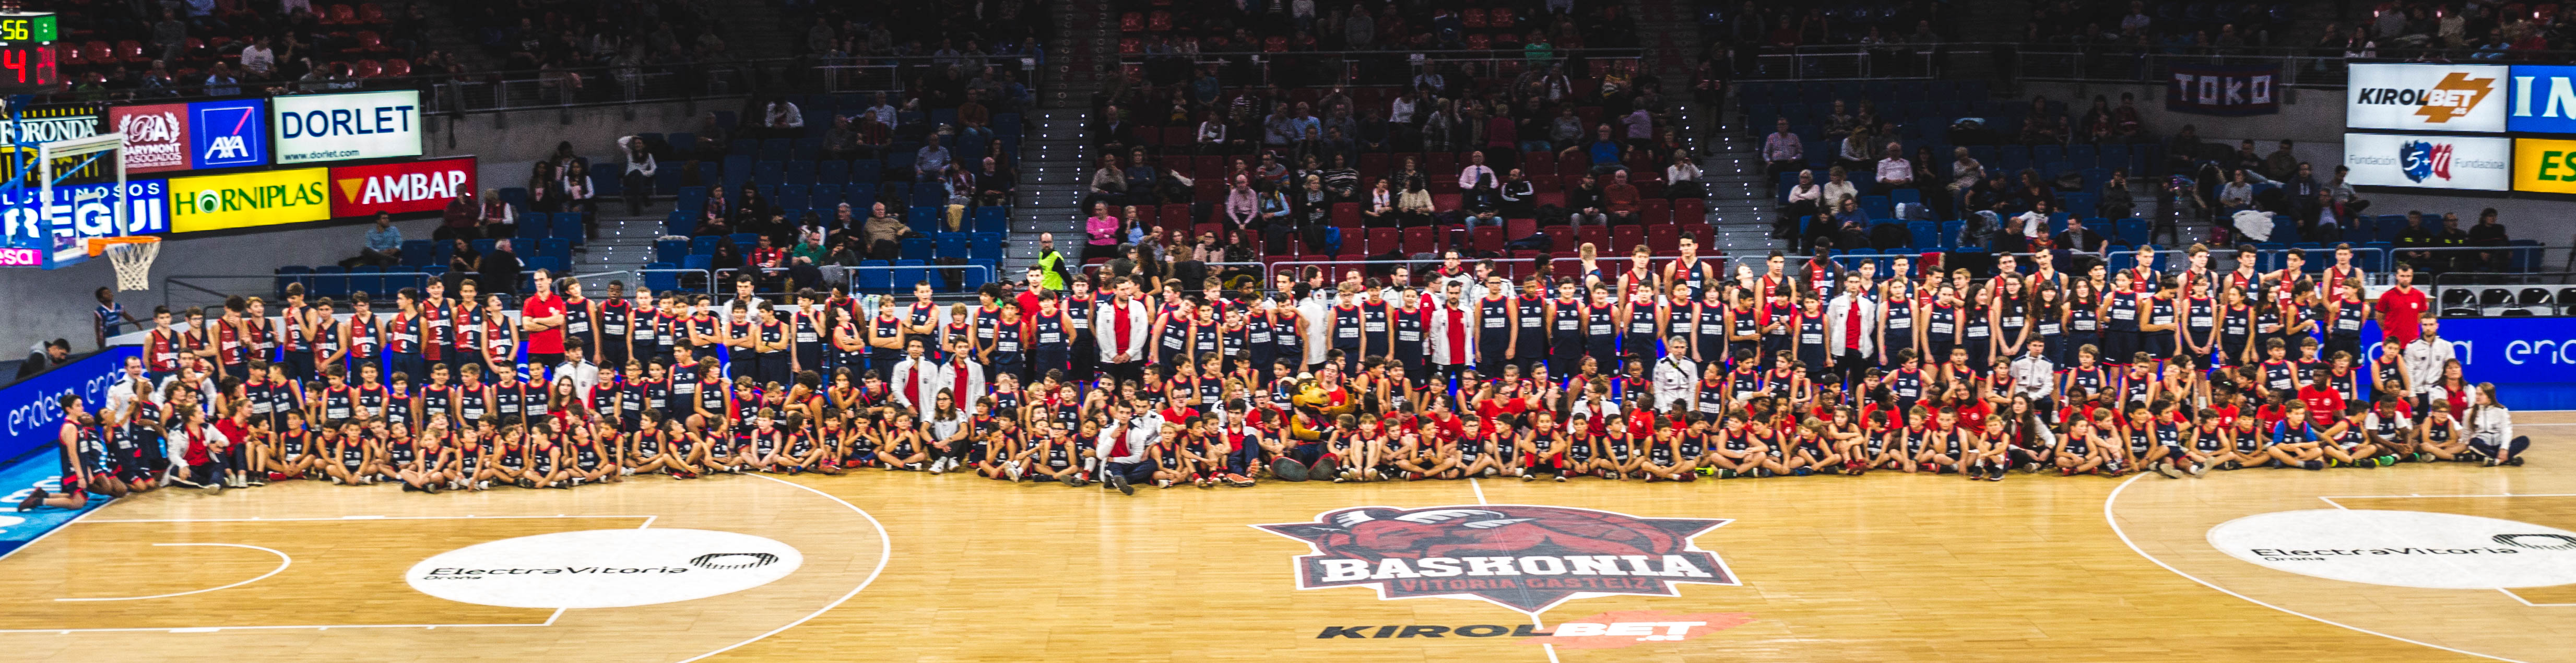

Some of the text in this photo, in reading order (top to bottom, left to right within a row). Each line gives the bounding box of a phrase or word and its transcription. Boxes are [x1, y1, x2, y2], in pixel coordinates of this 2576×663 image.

[2358, 88, 2477, 107] KIROLBET
[282, 106, 413, 139] DORLET
[205, 135, 249, 159] AXA
[283, 150, 359, 160] www.dorlet.com
[2349, 155, 2396, 165] Fundación
[175, 182, 323, 215] HORNIPLAS
[2251, 547, 2518, 557] ElectraVitoria
[430, 567, 689, 575] ElectraVitoria
[1319, 555, 1713, 582] BASKONIA
[1317, 621, 1707, 638] KIROLBET
